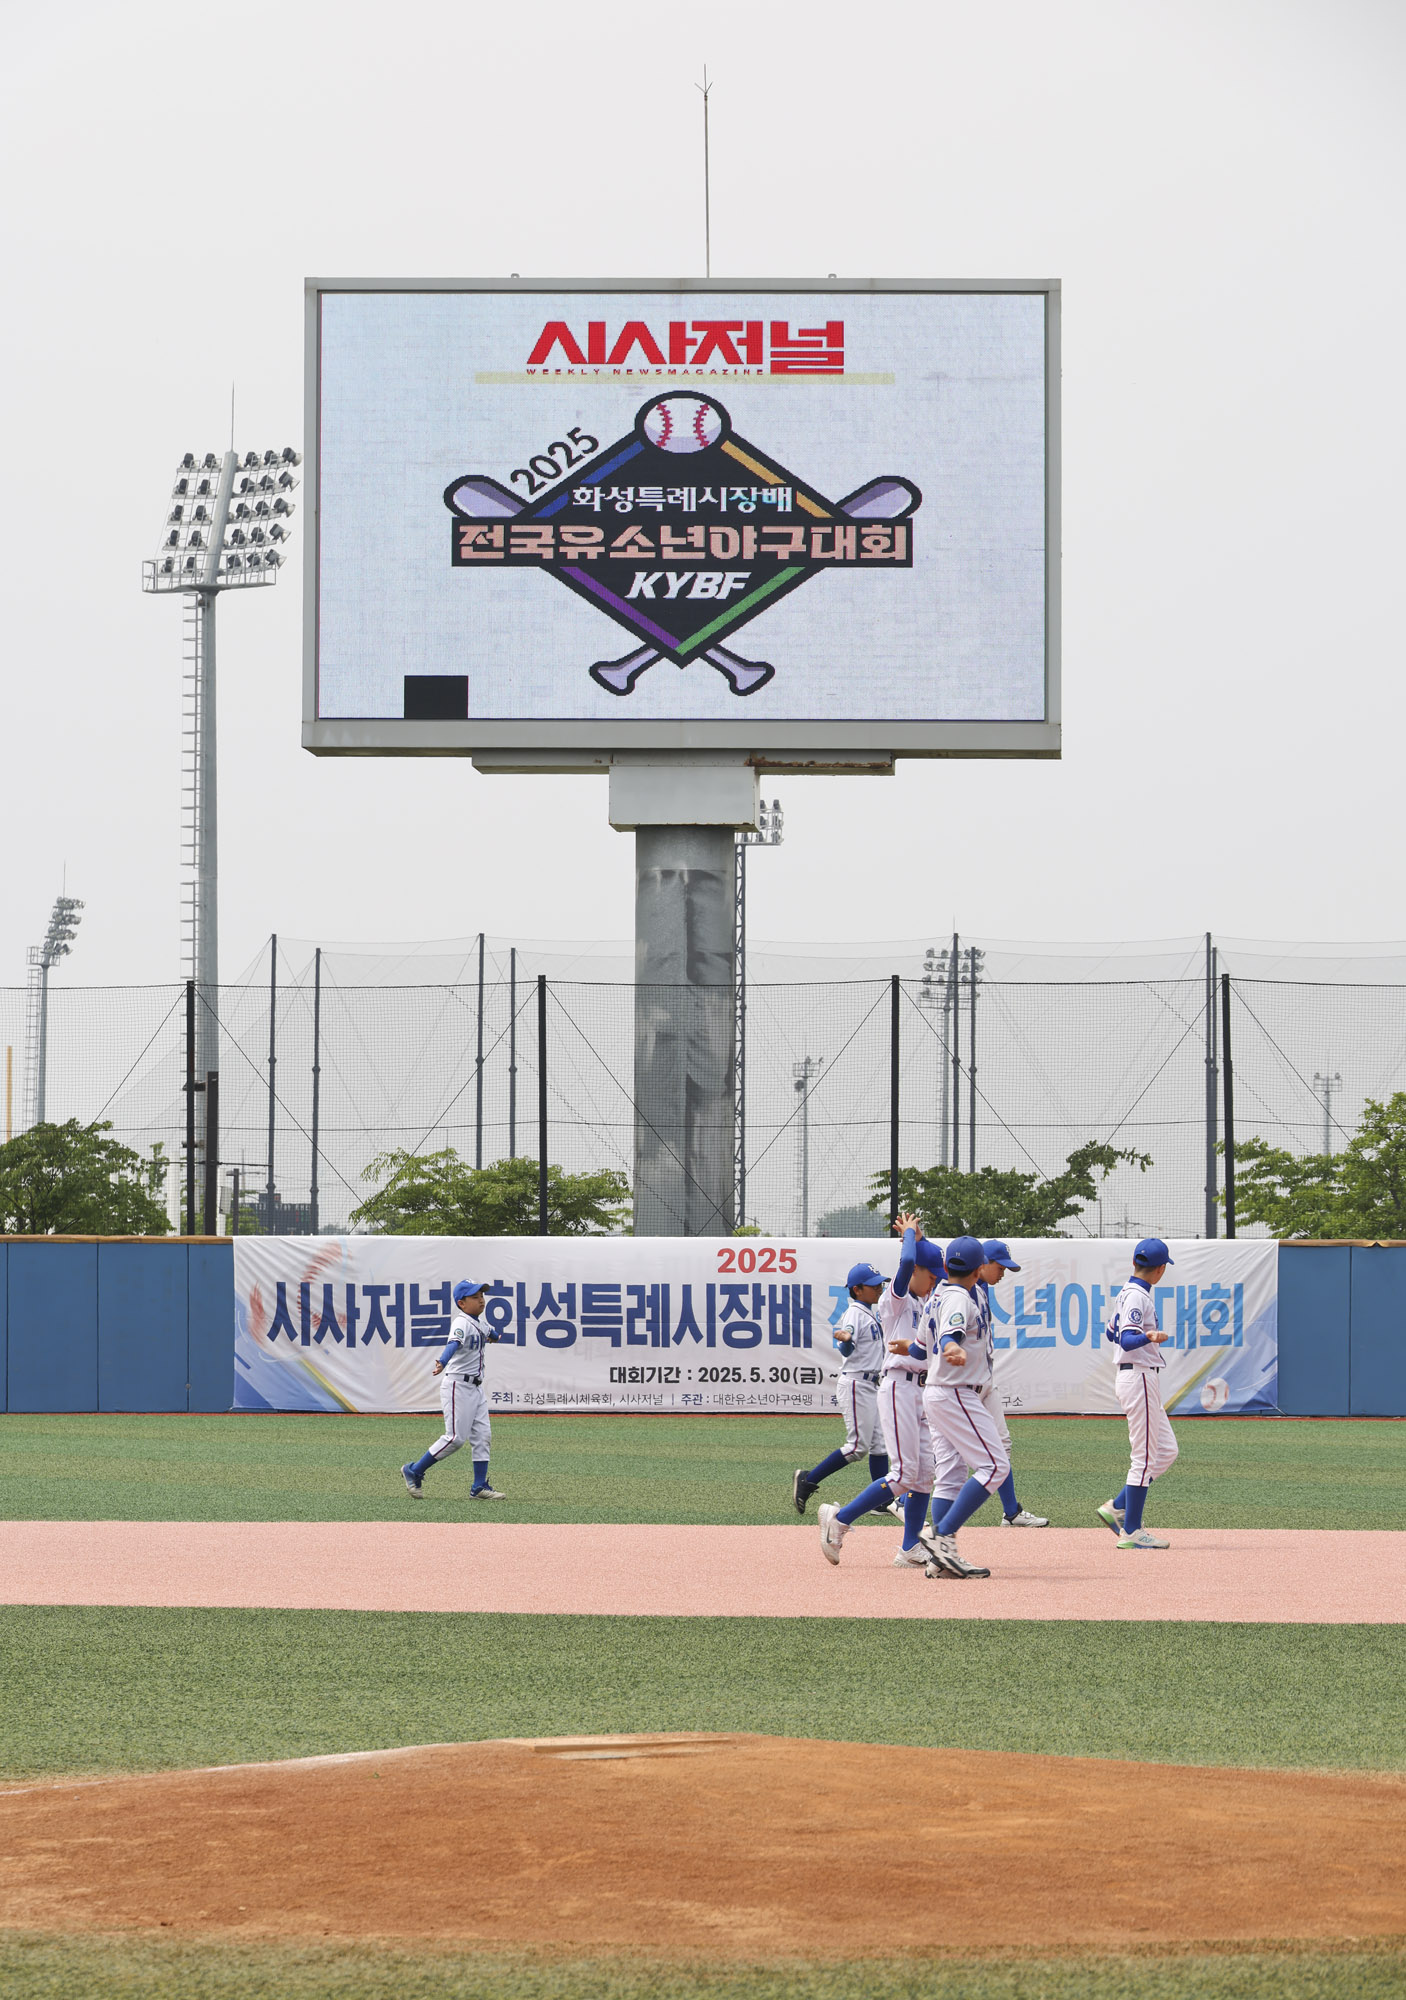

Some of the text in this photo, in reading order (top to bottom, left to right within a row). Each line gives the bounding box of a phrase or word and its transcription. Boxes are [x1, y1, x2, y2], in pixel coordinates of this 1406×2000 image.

[526, 320, 844, 375] 시사저널
[510, 427, 600, 495] 2025
[572, 486, 792, 512] 화성특례시장배
[458, 524, 908, 560] 전국유소년야구대회
[624, 571, 751, 599] KYBF
[717, 1248, 797, 1274] 2025
[267, 1281, 451, 1348] 시사저널
[483, 1279, 813, 1349] 화성특례시장배
[609, 1366, 681, 1384] 대회기간
[491, 1391, 514, 1405] 주최
[619, 1394, 663, 1406] 시사저널
[681, 1394, 703, 1406] 주관
[713, 1394, 813, 1406] 대한유소년야구연맹
